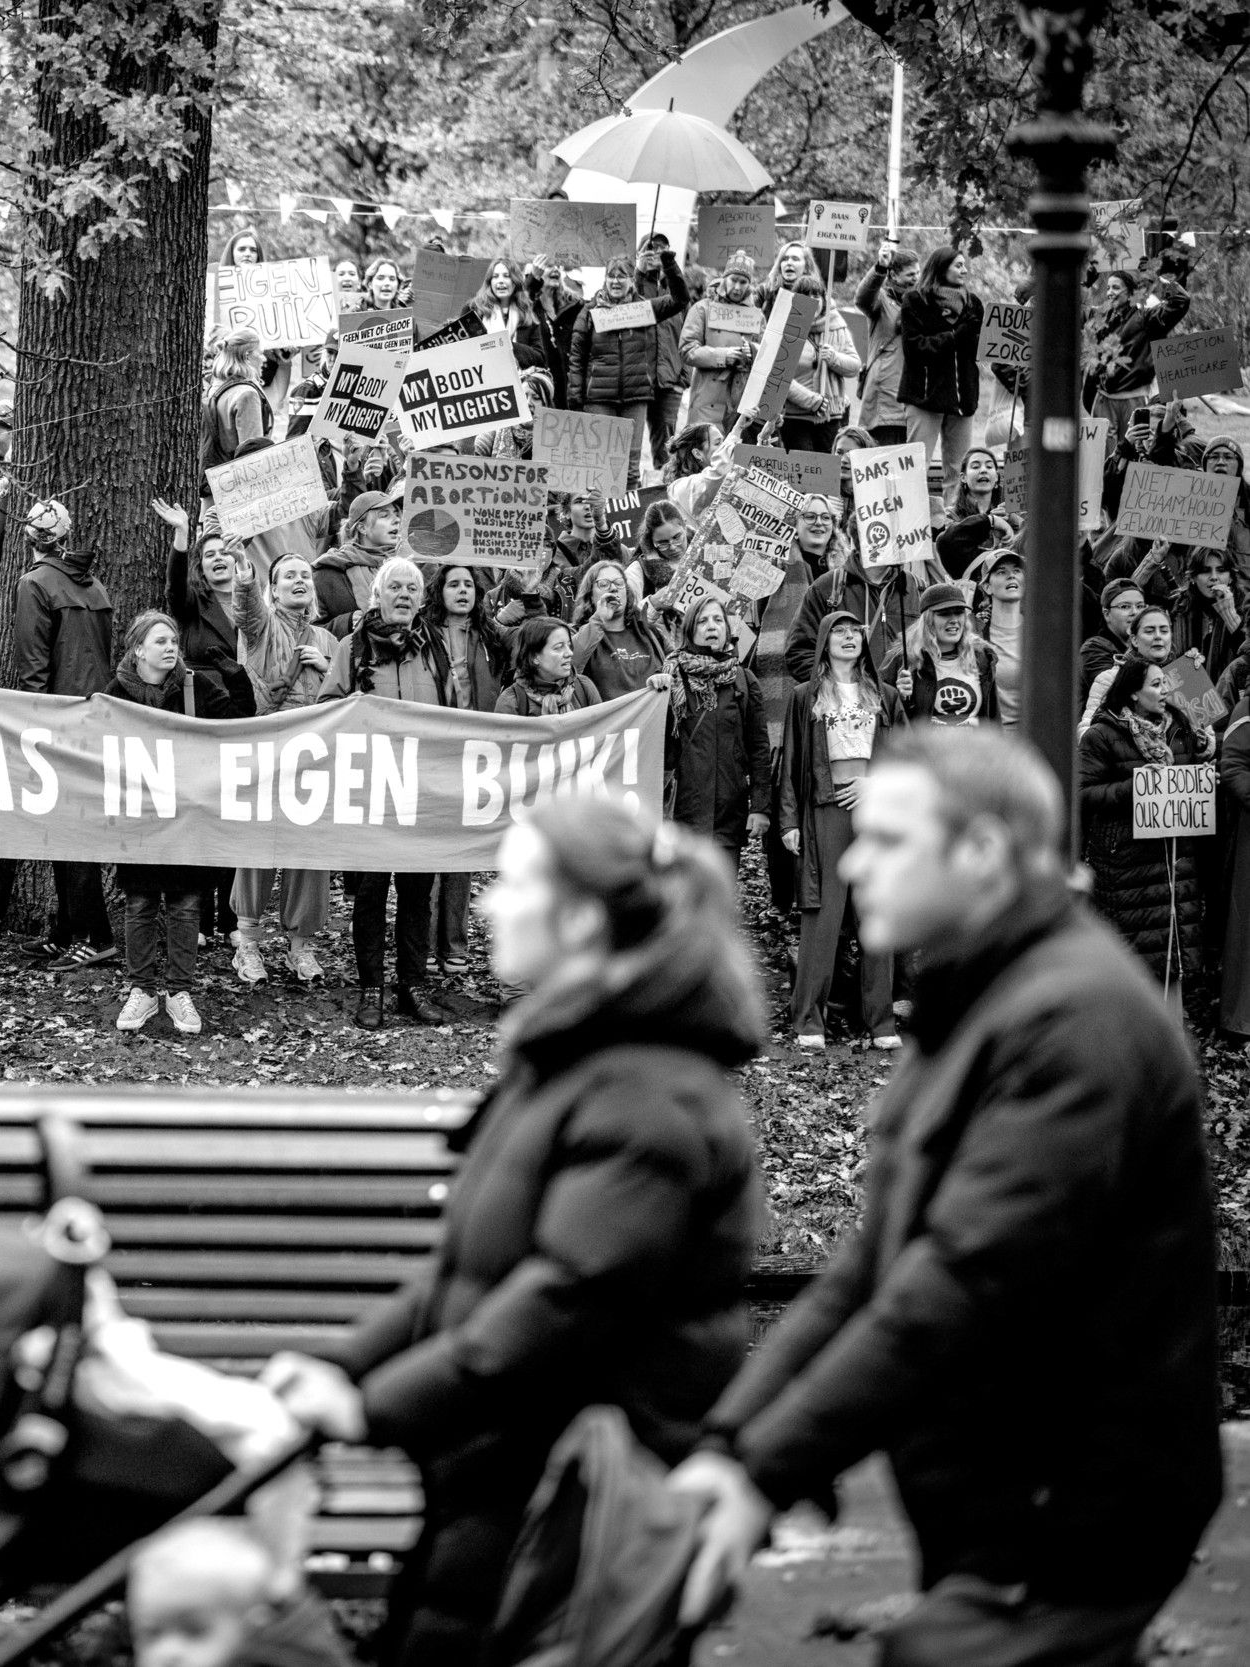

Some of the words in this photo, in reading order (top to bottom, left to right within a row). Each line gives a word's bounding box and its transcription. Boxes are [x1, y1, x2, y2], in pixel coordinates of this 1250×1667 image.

[717, 212, 763, 224] ABORTUS
[831, 212, 850, 221] BAAS
[725, 227, 735, 236] IS
[739, 225, 758, 235] EEN
[817, 231, 838, 239] EIGEN
[839, 232, 857, 242] BUIK
[218, 257, 320, 305] EIGEN
[361, 328, 374, 341] WET
[375, 325, 385, 336] OF
[386, 319, 410, 333] GELOOF
[986, 305, 1033, 331] ABOR
[985, 342, 1032, 362] ZORG
[1157, 335, 1225, 359] ABORTION
[336, 371, 359, 394] MY
[356, 375, 388, 399] BODY
[402, 377, 429, 404] MY
[435, 364, 484, 395] BODY
[324, 402, 348, 423] MY
[343, 405, 384, 431] RIGHTS
[411, 408, 437, 433] MY
[443, 390, 512, 425] RIGHTS
[541, 412, 602, 449] BAAS
[607, 420, 630, 454] IN
[411, 457, 513, 482] REASONS
[514, 465, 548, 484] FOR
[749, 455, 789, 473] ABORTUS
[791, 461, 800, 473] IS
[854, 461, 889, 484] BAAS
[898, 455, 914, 471] IN
[1130, 470, 1175, 493] NIET
[1184, 475, 1225, 498] JOUW
[473, 508, 500, 519] NONE
[503, 509, 516, 519] OF
[516, 509, 543, 522] YOUR
[857, 495, 903, 522] EIGEN
[1187, 497, 1225, 517] HOUD
[473, 528, 504, 539] NONE
[505, 531, 516, 539] OF
[518, 531, 542, 541] YOUR
[741, 503, 794, 540] MANNEN
[1118, 511, 1166, 534] GEWOON
[1167, 518, 1186, 536] JE
[745, 537, 772, 551] NIET
[774, 545, 790, 558] OK
[896, 524, 931, 550] BUIK
[103, 735, 177, 818] IN
[219, 732, 419, 826] EIGEN
[461, 728, 640, 826] BUIK!
[1135, 771, 1163, 797] OUR
[1135, 801, 1161, 829] OUR
